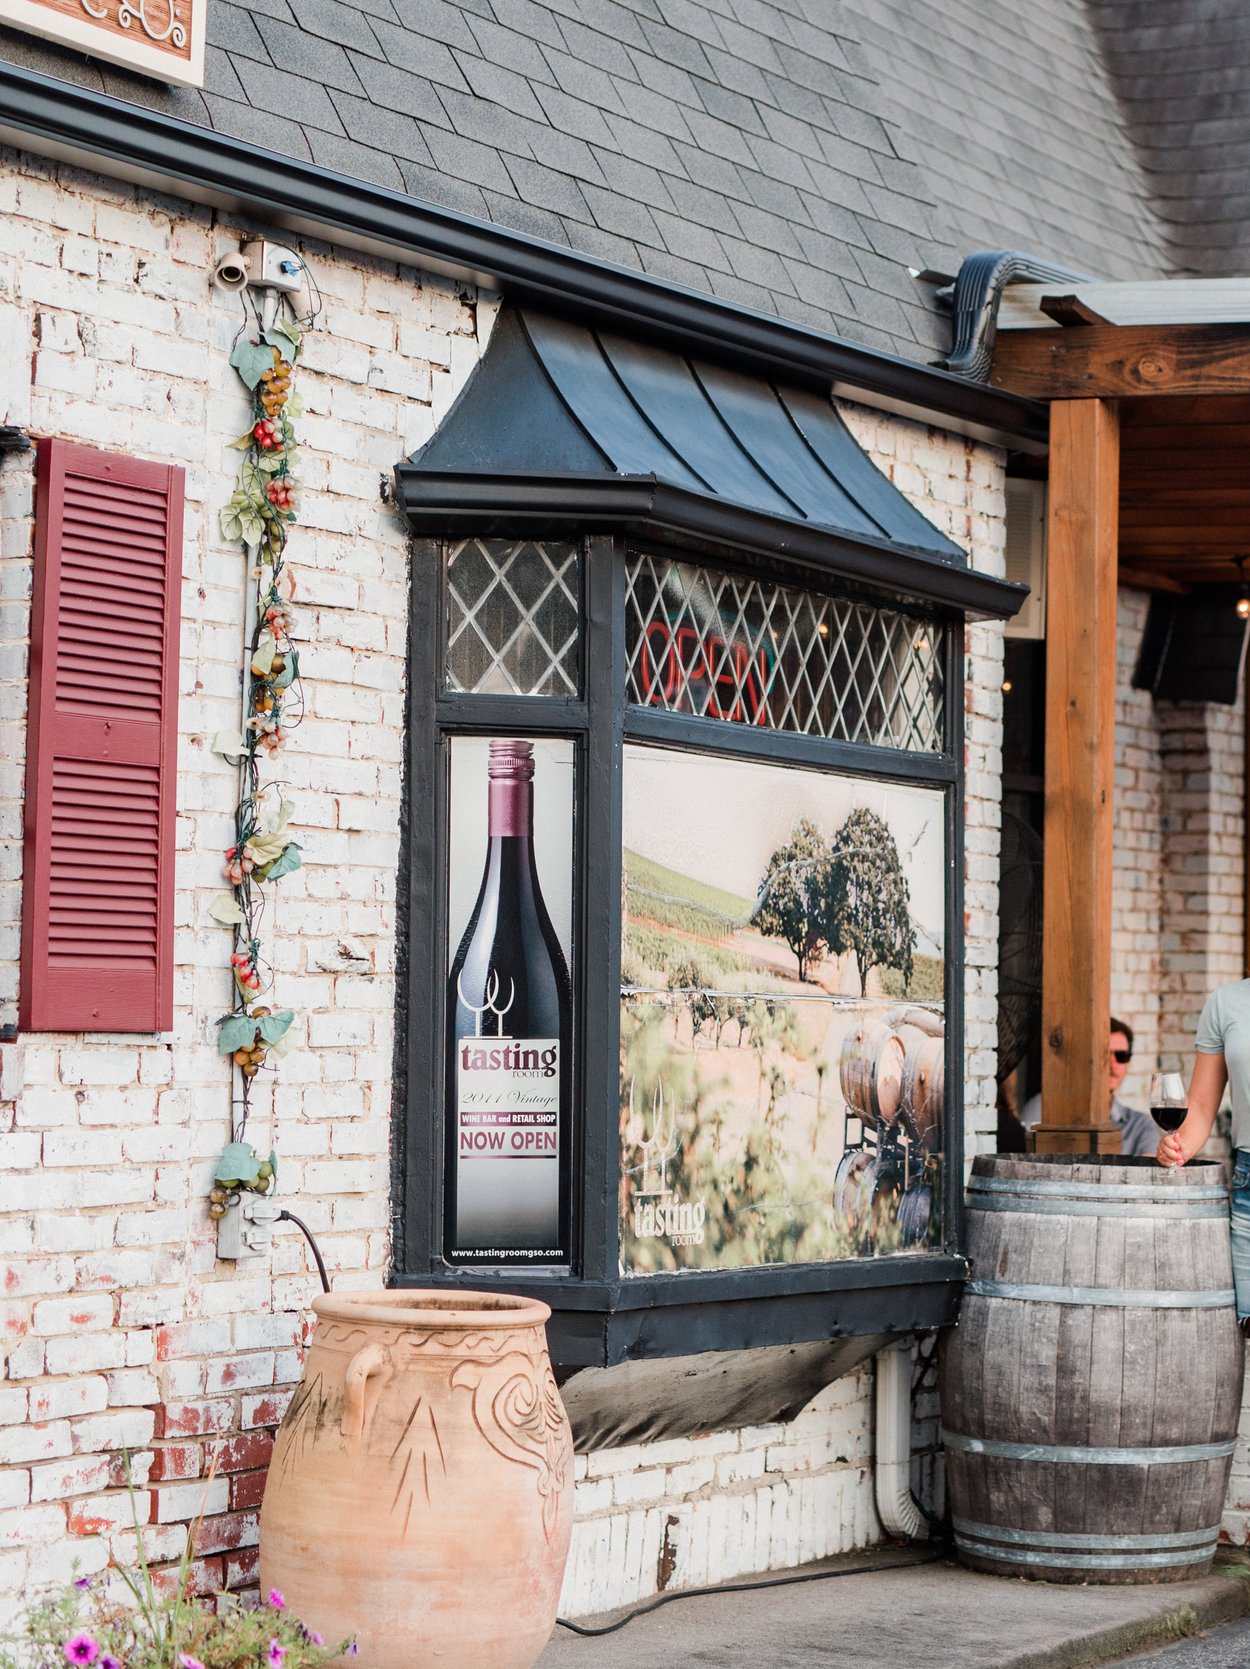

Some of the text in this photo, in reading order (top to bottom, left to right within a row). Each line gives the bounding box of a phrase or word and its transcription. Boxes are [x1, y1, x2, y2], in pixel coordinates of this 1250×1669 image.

[641, 620, 766, 726] OPEN
[461, 1042, 557, 1078] tasting
[512, 1070, 544, 1078] room
[462, 1087, 558, 1109] 2011 Vintage
[461, 1114, 556, 1123] WINE BAR and RETAIL SHOP
[460, 1131, 557, 1150] NOW OPEN
[634, 1193, 706, 1245] tasting
[671, 1235, 697, 1247] room
[451, 1248, 564, 1259] www.tastingroomgso.com
